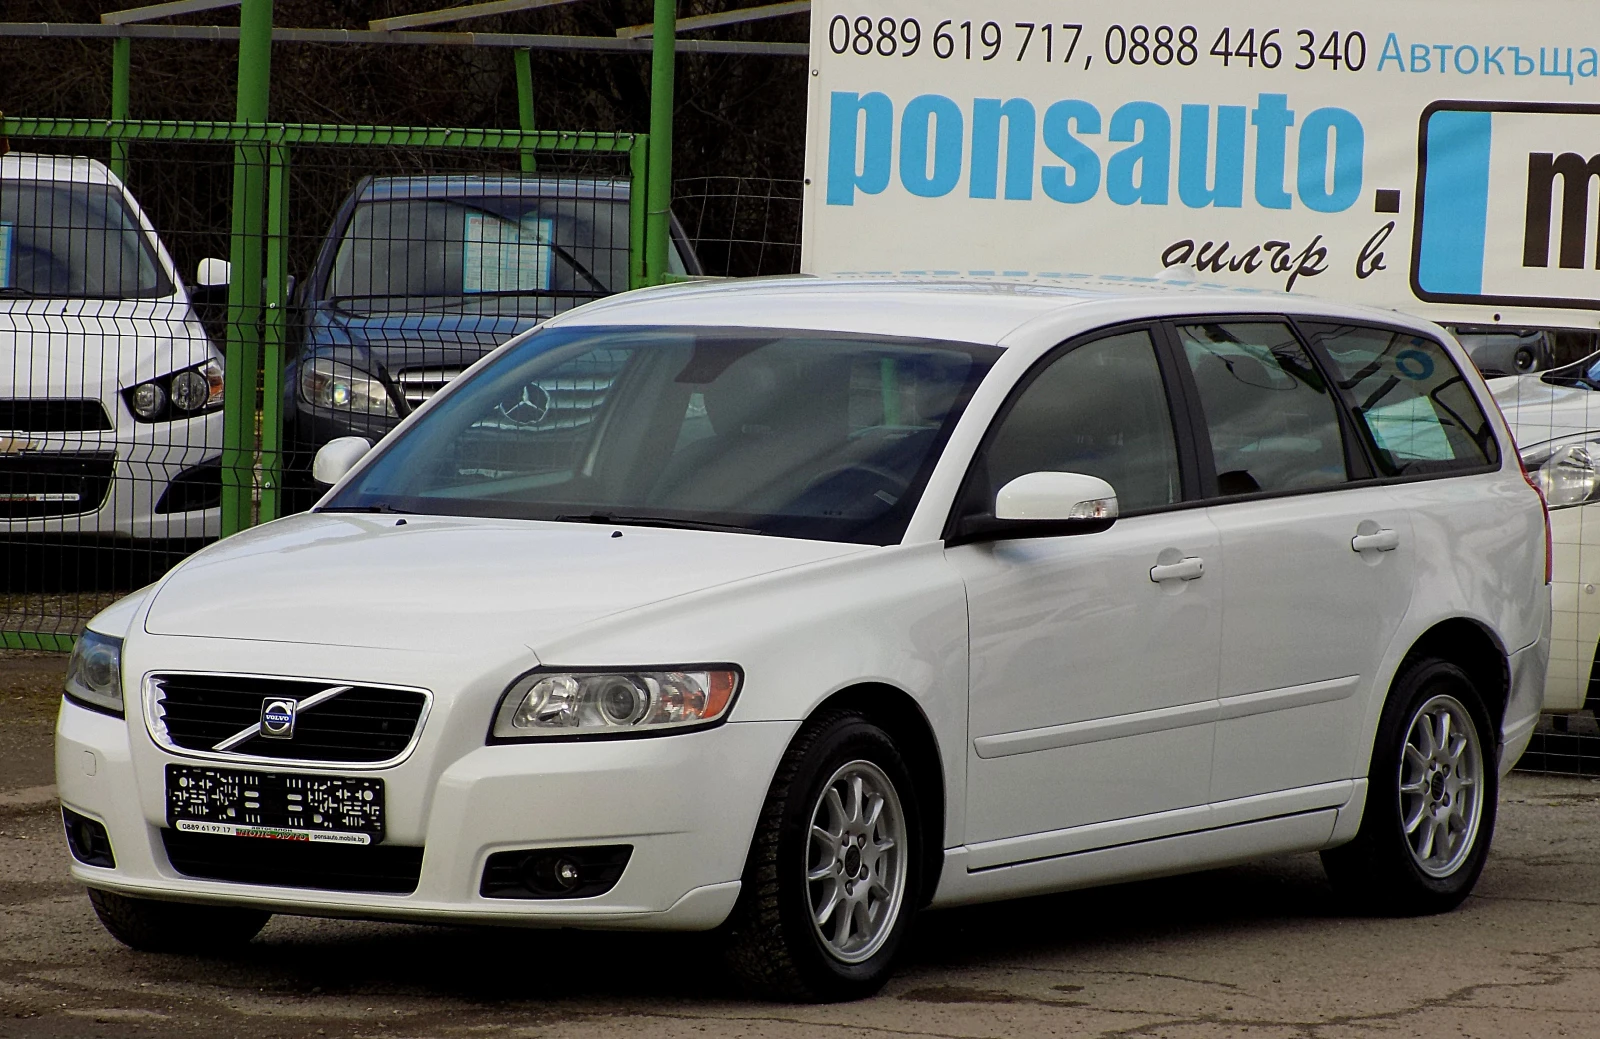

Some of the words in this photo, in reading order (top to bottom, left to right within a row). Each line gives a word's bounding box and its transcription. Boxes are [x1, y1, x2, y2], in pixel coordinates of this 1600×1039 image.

[828, 14, 922, 58] 0889
[932, 19, 1002, 61] 619
[1014, 22, 1092, 70] 717,
[1104, 24, 1199, 66] 0888
[1209, 27, 1283, 69] 446
[1294, 29, 1367, 71] 340
[1376, 32, 1598, 85] Автокъща
[1355, 220, 1395, 280] в
[265, 714, 290, 722] VOLVO
[182, 823, 200, 831] 0889
[211, 825, 220, 833] 97
